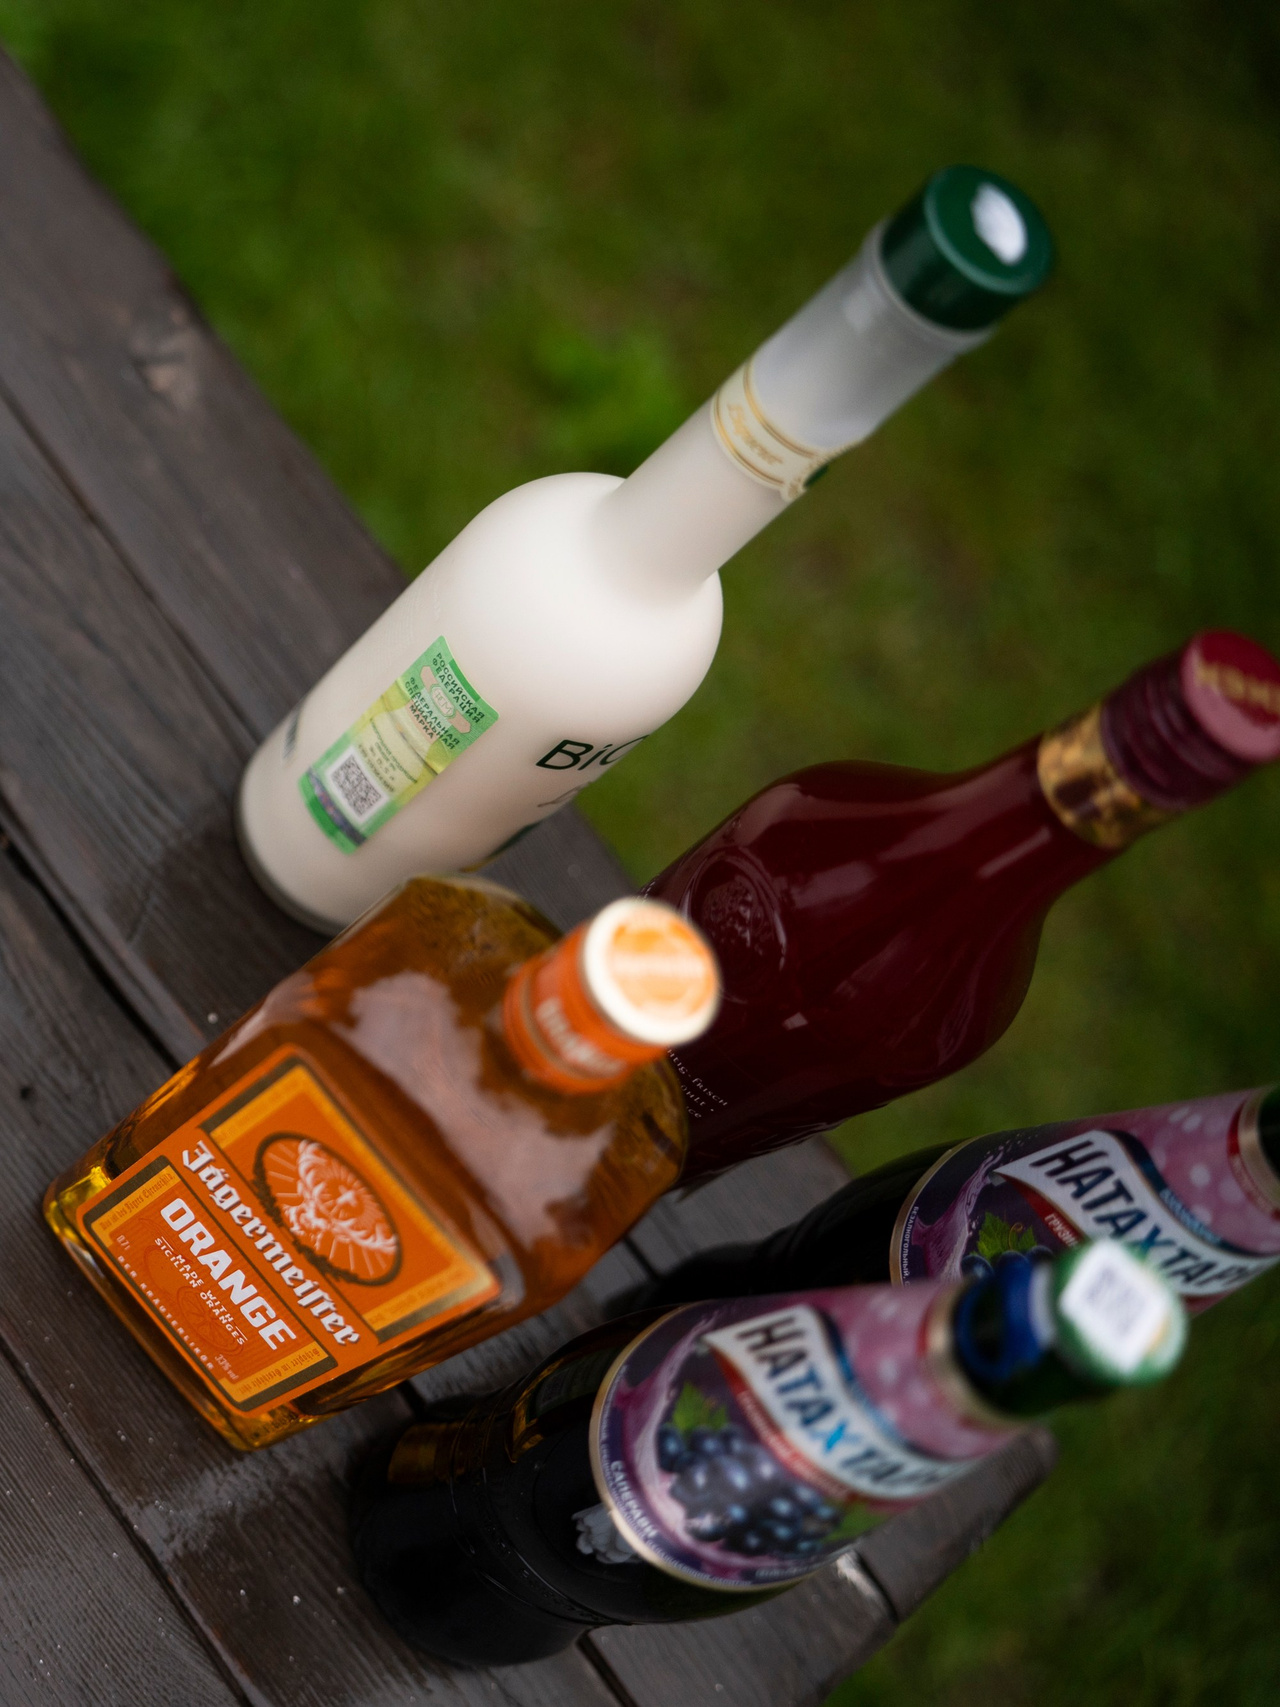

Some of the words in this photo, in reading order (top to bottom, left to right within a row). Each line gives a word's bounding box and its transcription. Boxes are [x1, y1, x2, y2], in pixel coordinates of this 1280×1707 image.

[405, 682, 455, 749] СПЕЦИАЛЬНАЯ
[410, 677, 460, 745] ФЕДЕРАЛЬНАЯ
[432, 658, 480, 723] ФЕДЕРАЦИЯ
[436, 653, 485, 719] РОССИЙСКАЯ
[409, 704, 434, 739] МАРКА
[160, 1198, 296, 1350] ORANGE
[181, 1140, 360, 1345] Jägermeister
[117, 1255, 138, 1278] DER
[139, 1282, 215, 1371] KRÄUTERLIKÖR
[154, 1238, 198, 1288] SICILIAN
[199, 1291, 245, 1345] ORANGES
[176, 1254, 205, 1286] MADE
[206, 1290, 234, 1323] WITH
